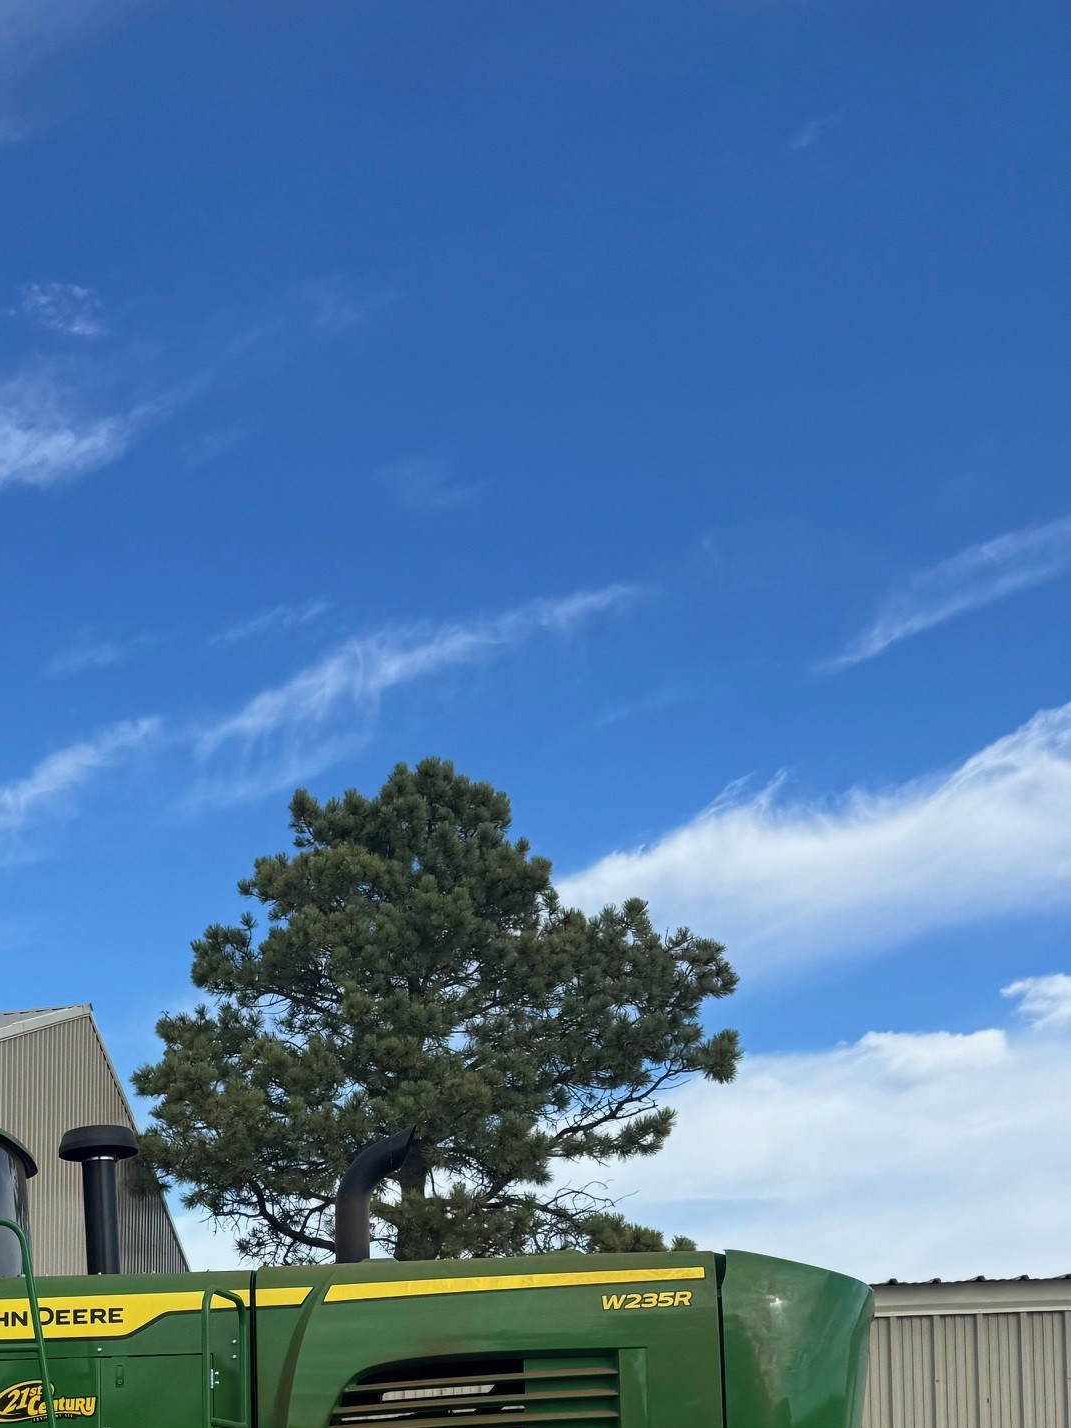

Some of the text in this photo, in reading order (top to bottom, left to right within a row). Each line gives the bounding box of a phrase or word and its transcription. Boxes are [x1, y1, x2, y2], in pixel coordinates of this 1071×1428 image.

[601, 1291, 692, 1310] W235R
[39, 1307, 124, 1326] DEERE
[2, 1386, 43, 1414] 21st
